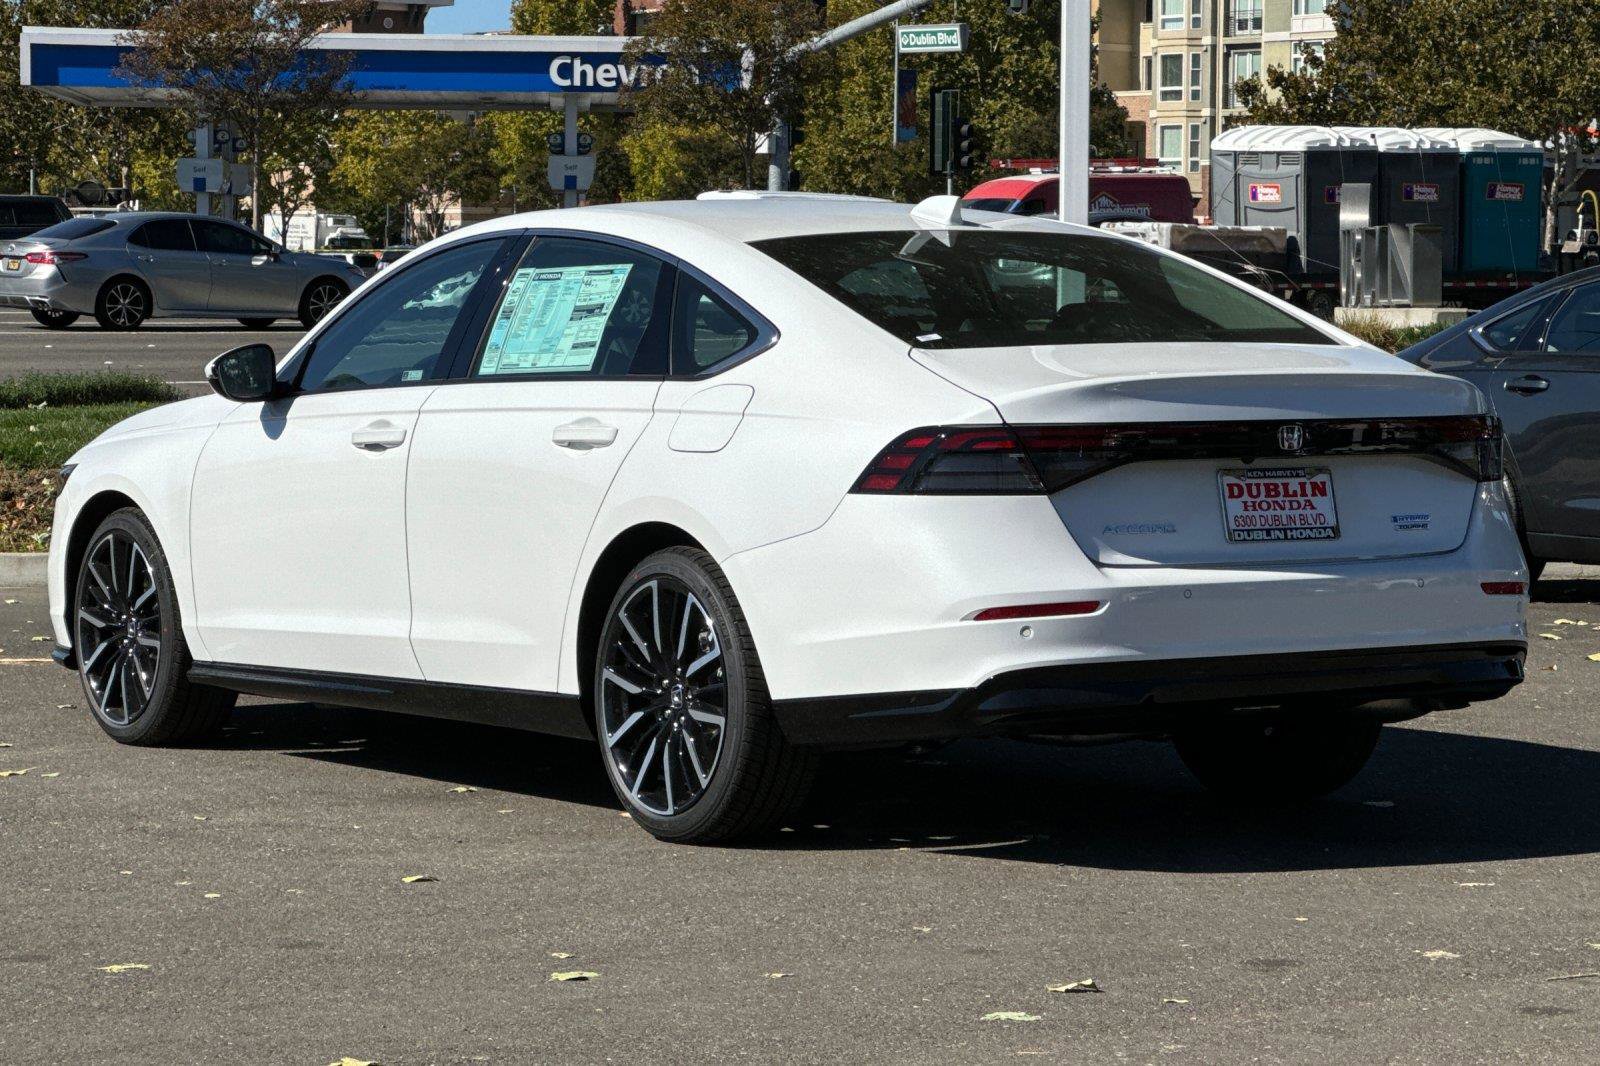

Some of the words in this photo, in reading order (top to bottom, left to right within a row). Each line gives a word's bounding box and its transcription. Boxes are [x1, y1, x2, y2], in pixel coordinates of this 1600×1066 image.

[909, 33, 937, 45] Dublin
[937, 32, 958, 45] Blvd
[1413, 184, 1436, 193] Honey
[1496, 184, 1520, 193] Honey
[1413, 192, 1438, 200] Bucket
[1495, 192, 1522, 200] Bucket
[540, 272, 562, 280] HONDA
[1247, 470, 1264, 478] KEN
[1265, 469, 1305, 478] HARVEY'S
[1226, 481, 1328, 499] DUBLIN
[1241, 499, 1317, 512] HONDA
[1233, 514, 1257, 528] 6300
[1259, 514, 1297, 527] DUBLIN
[1299, 513, 1329, 526] BLVD.
[1234, 529, 1285, 541] DUBLIN
[1287, 528, 1335, 540] HONDA
